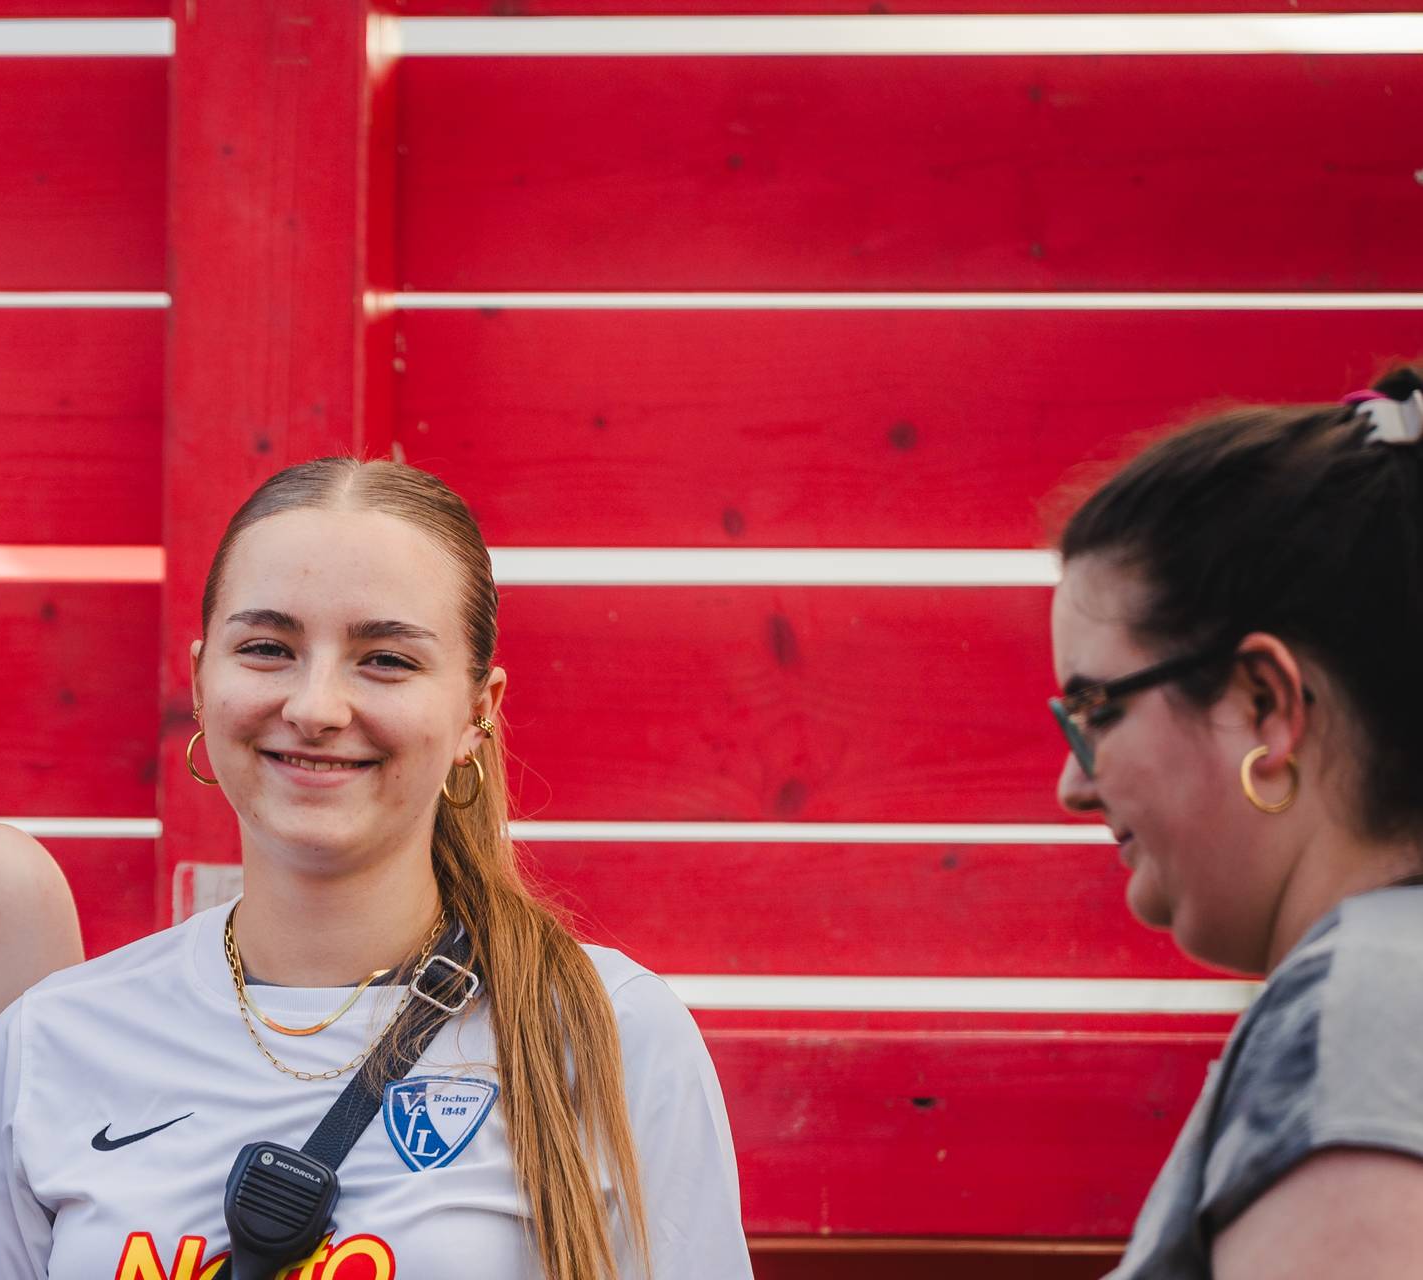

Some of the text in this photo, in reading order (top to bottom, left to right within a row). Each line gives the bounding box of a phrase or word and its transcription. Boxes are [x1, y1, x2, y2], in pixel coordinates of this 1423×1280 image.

[433, 1094, 479, 1103] Bochum
[397, 1091, 440, 1158] VfL
[275, 1160, 322, 1184] MOTOROLA
